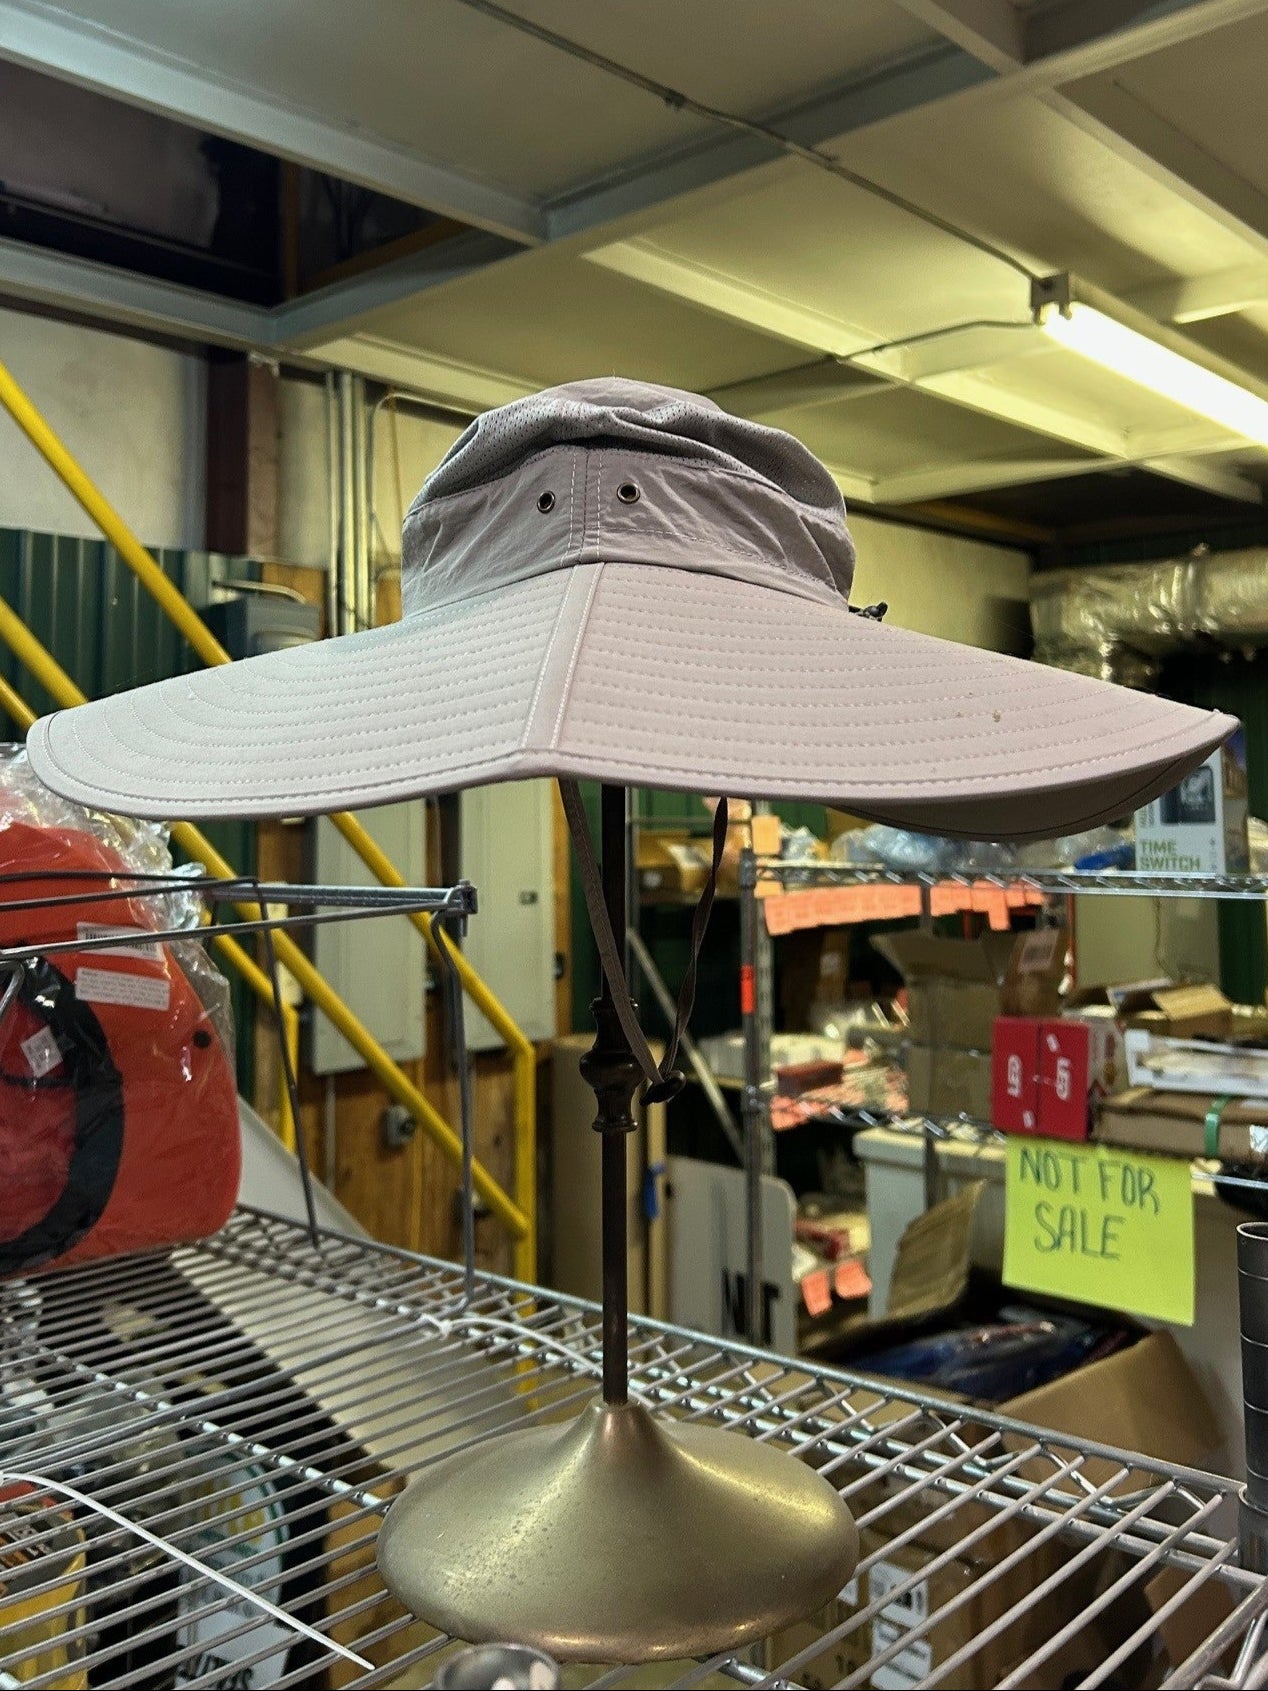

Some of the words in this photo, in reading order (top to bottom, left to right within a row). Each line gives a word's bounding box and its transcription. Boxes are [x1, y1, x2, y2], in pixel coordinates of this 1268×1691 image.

[1141, 841, 1176, 856] TIME
[1141, 857, 1200, 871] SWITCH
[1019, 1147, 1088, 1194] NOT
[1097, 1159, 1160, 1216] FOR
[1034, 1200, 1126, 1262] SALE
